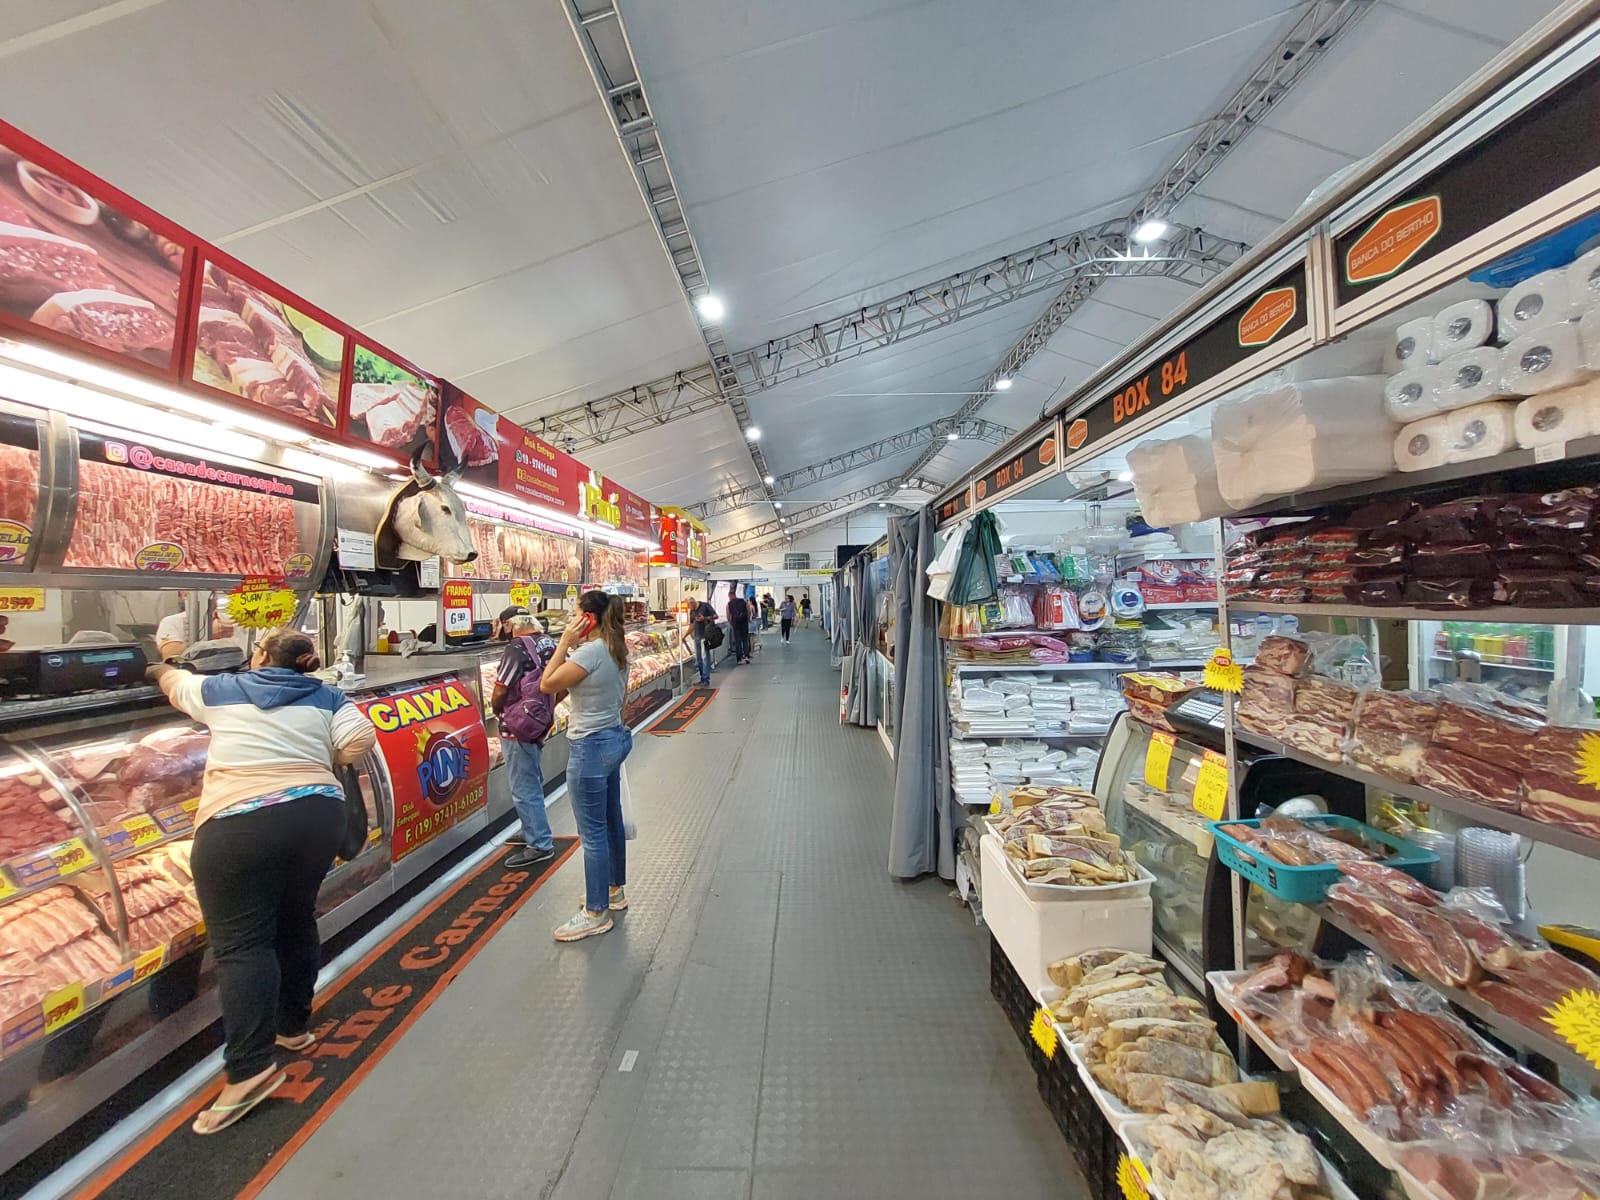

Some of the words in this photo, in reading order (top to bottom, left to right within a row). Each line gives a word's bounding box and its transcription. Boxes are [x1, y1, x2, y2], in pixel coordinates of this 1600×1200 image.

[1351, 246, 1380, 270] BANCA
[1380, 236, 1394, 252] DO
[1396, 210, 1434, 242] BERTHO
[1113, 375, 1151, 424] BOX
[1161, 351, 1188, 395] 84
[129, 446, 294, 496] @casadecarnespine
[996, 465, 1011, 488] BOX
[1013, 457, 1024, 480] 84
[446, 585, 471, 597] FRANGO
[368, 685, 471, 733] CAIXA
[415, 817, 433, 840] (19)
[434, 789, 478, 825] 97411-6103
[399, 870, 530, 971] Carnes
